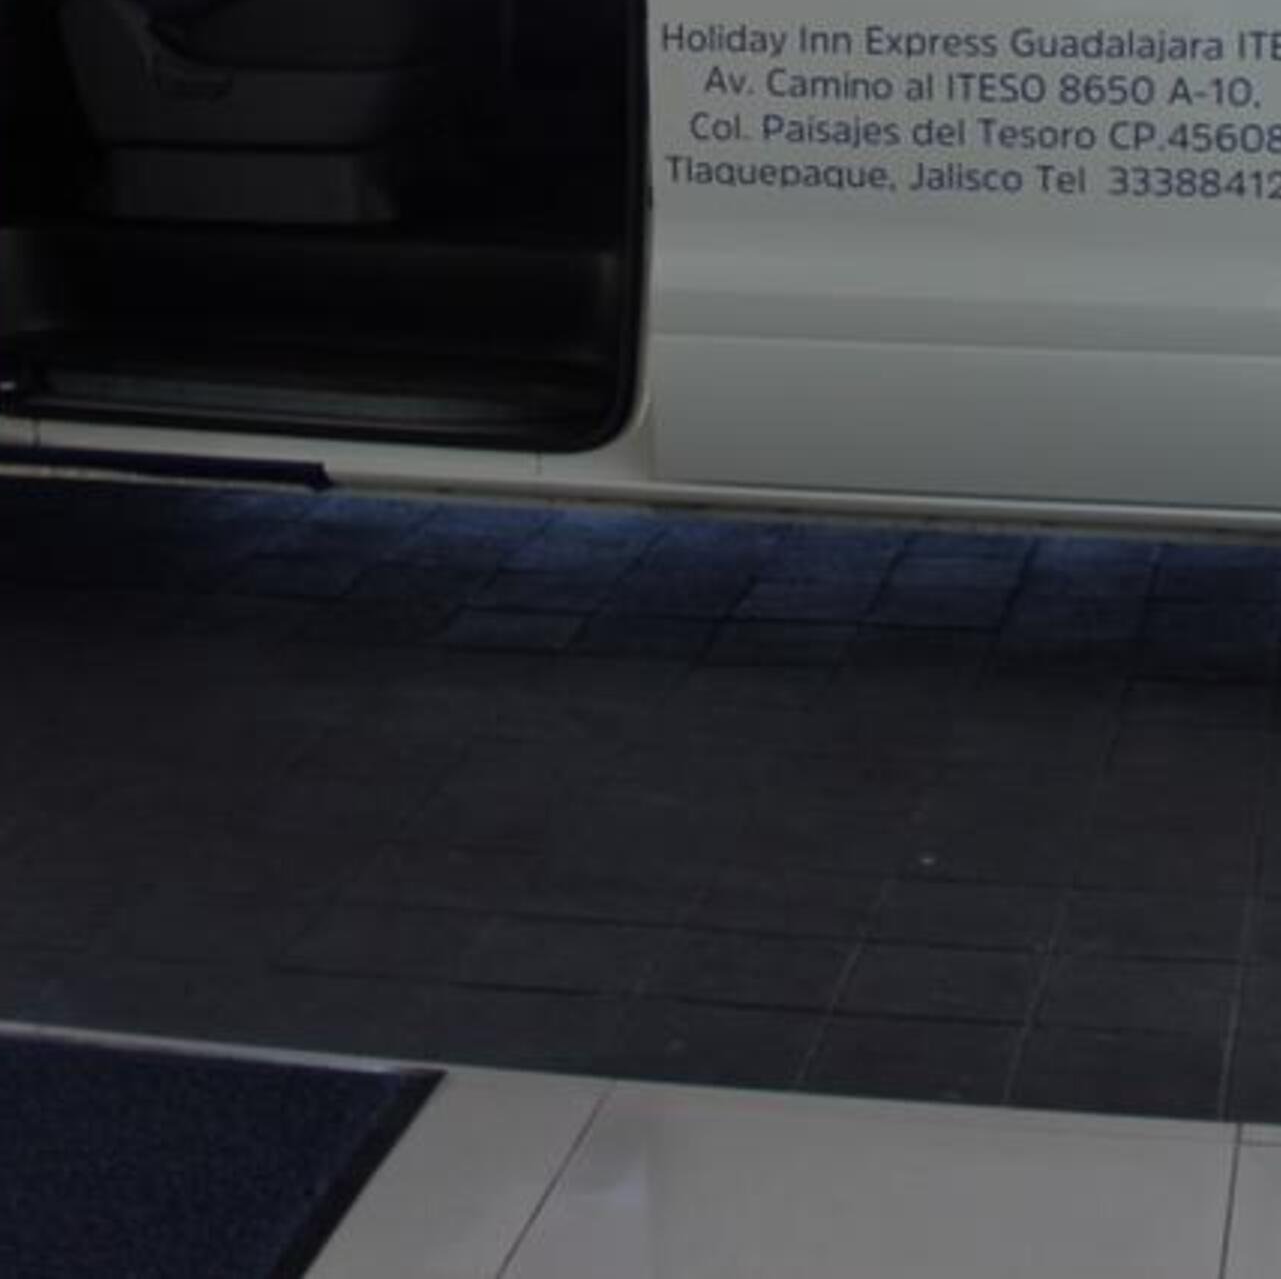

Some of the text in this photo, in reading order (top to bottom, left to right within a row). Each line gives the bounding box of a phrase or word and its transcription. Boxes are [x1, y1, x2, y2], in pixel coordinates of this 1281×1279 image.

[662, 23, 787, 58] Holiday
[799, 25, 853, 54] Inn
[866, 25, 998, 58] Express
[1009, 26, 1224, 64] Guadalajara
[703, 65, 755, 95] Av.
[765, 68, 893, 101] Camino
[905, 70, 934, 101] al
[948, 71, 1046, 104] ITESO
[1058, 73, 1155, 106] 8650
[763, 113, 901, 149] Paisajes
[912, 117, 966, 147] del
[977, 118, 1096, 150] Tesoro
[908, 162, 1023, 192] Jalisco
